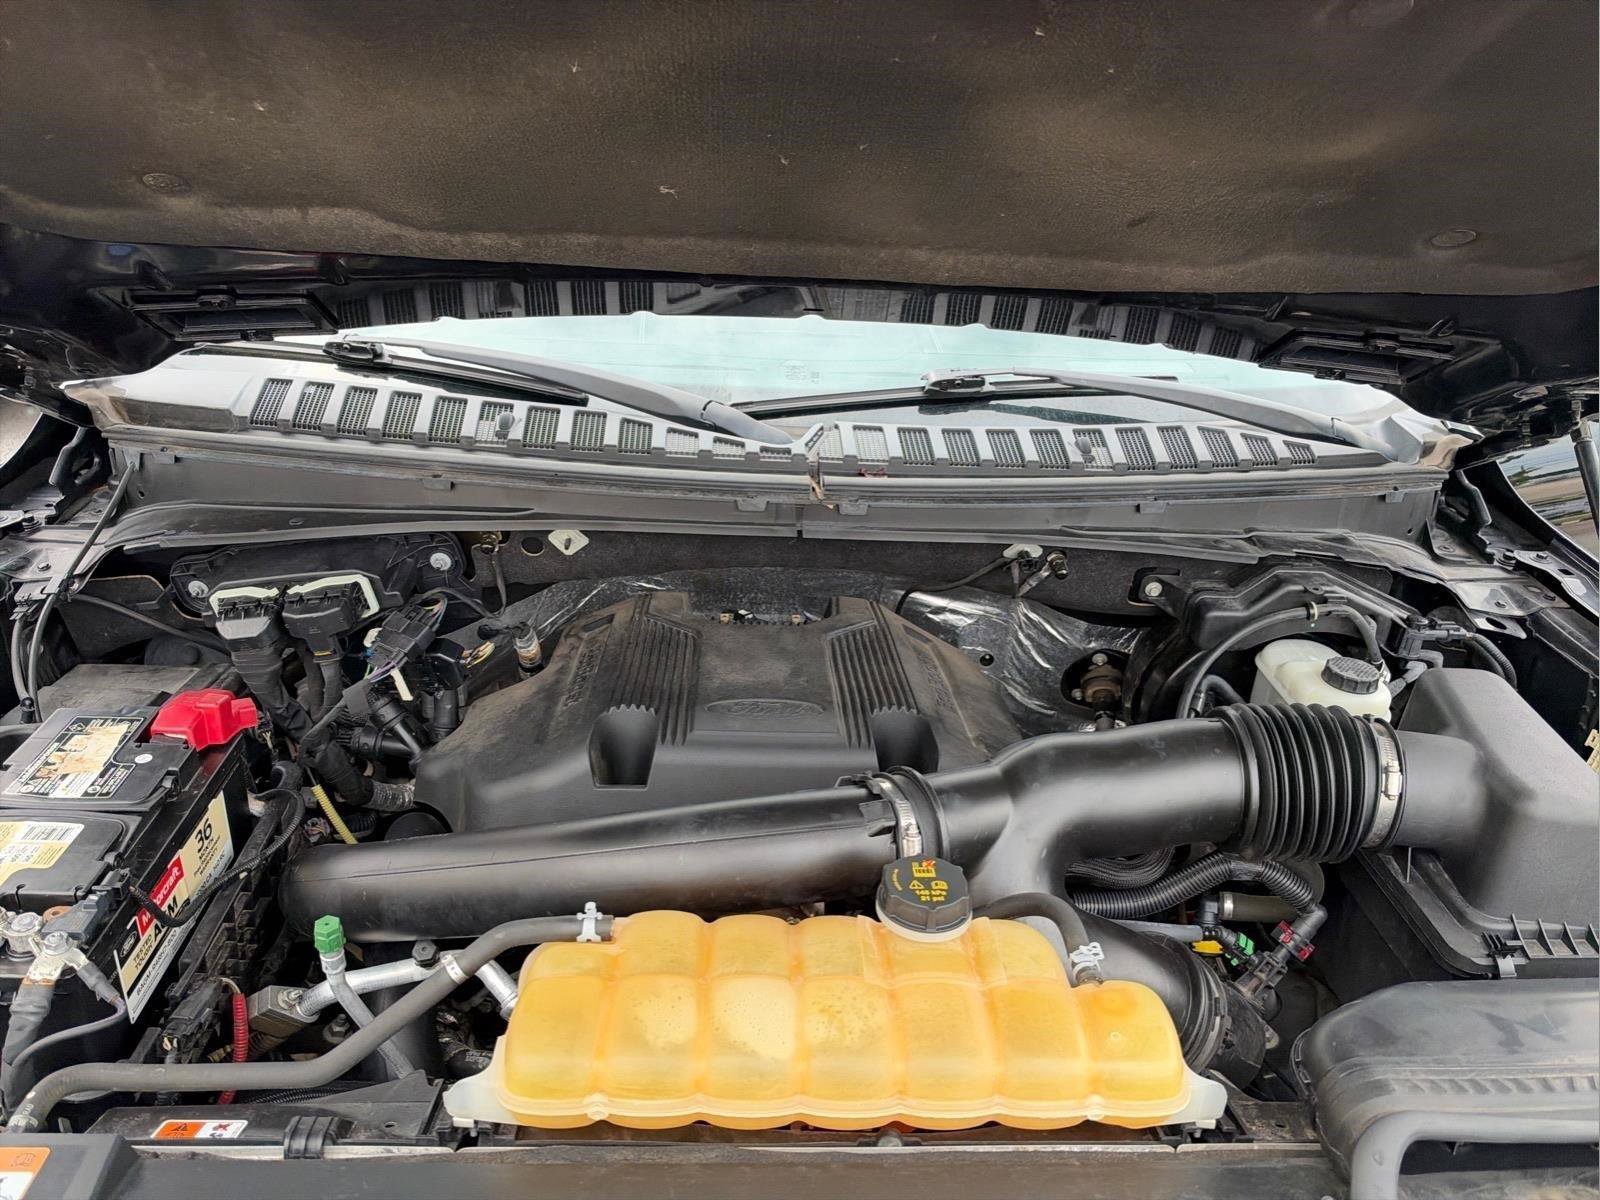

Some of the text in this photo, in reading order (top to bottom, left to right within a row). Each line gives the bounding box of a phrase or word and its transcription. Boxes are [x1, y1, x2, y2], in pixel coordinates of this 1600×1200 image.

[195, 818, 212, 853] 36
[141, 865, 182, 927] Morcraft
[153, 895, 178, 941] AM
[133, 934, 152, 961] TESTED
